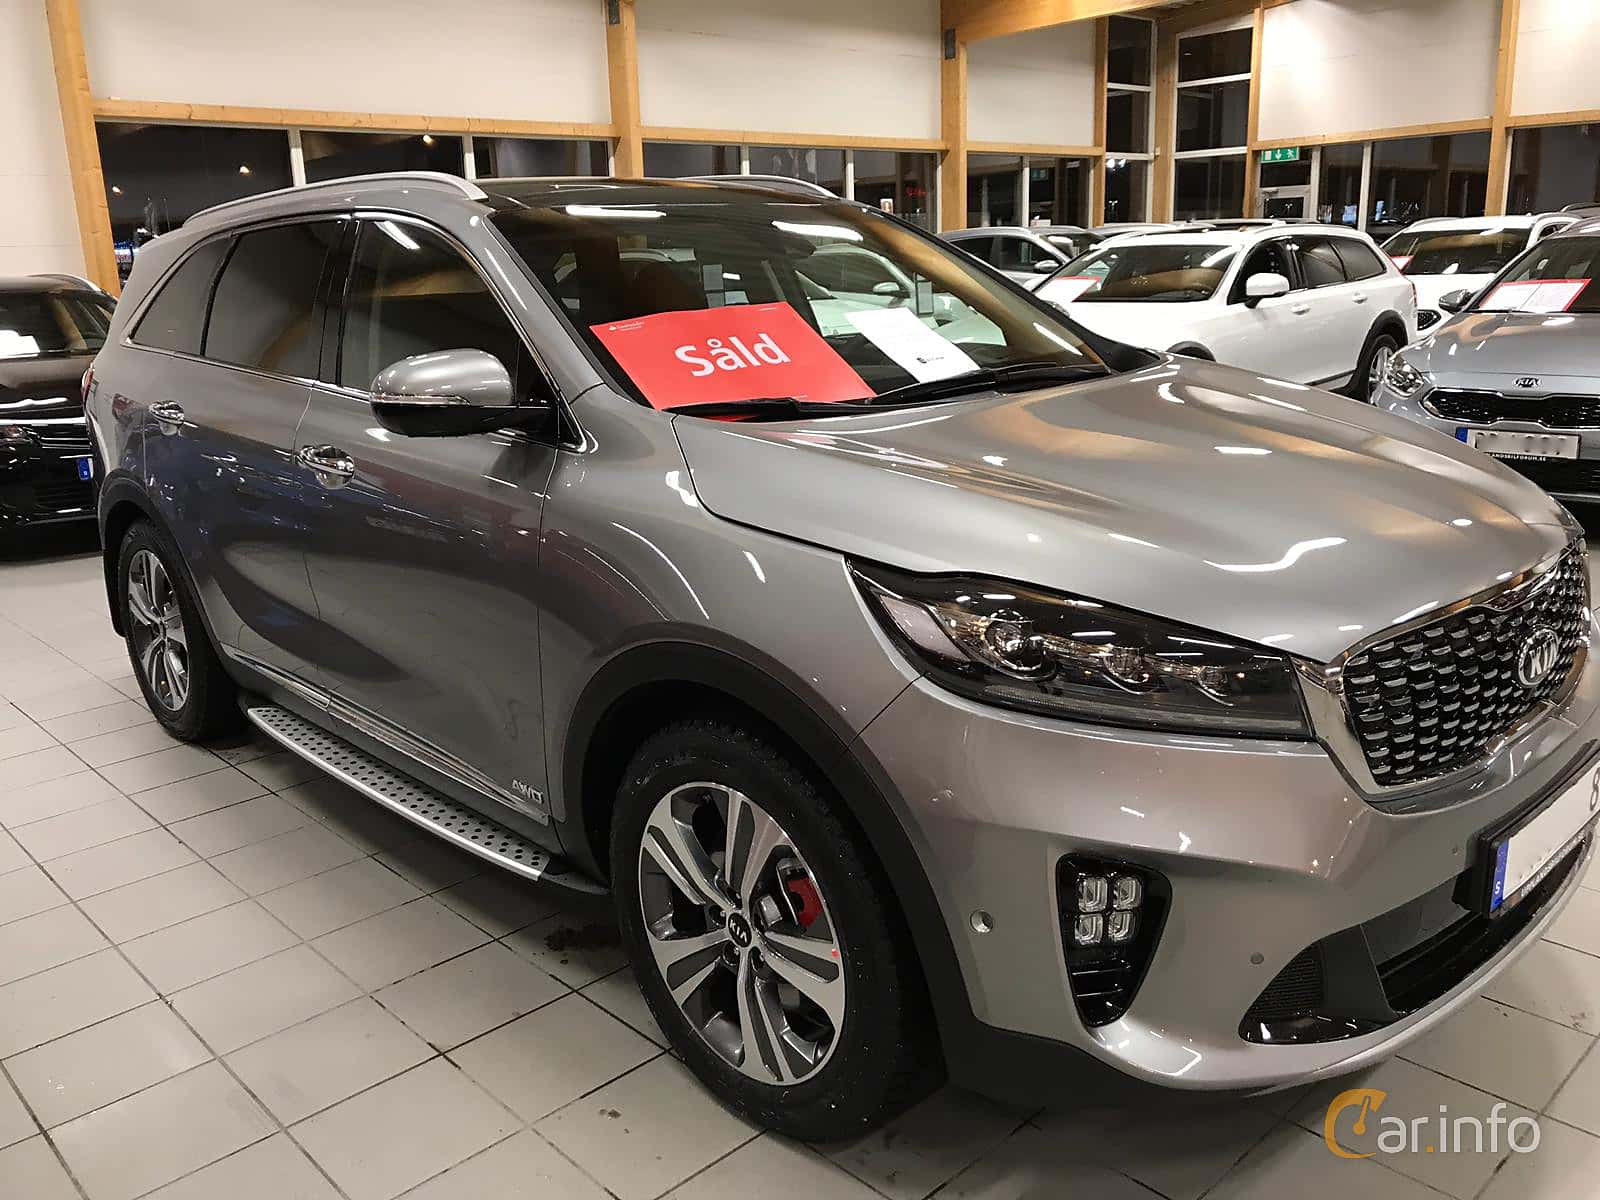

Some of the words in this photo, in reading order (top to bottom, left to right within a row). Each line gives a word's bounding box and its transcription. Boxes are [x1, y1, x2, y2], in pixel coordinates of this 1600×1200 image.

[674, 333, 791, 377] Såld
[1514, 377, 1541, 388] KIA
[1529, 638, 1558, 679] KIA
[512, 779, 544, 804] AWD
[1494, 880, 1502, 895] S
[730, 919, 748, 943] KIA
